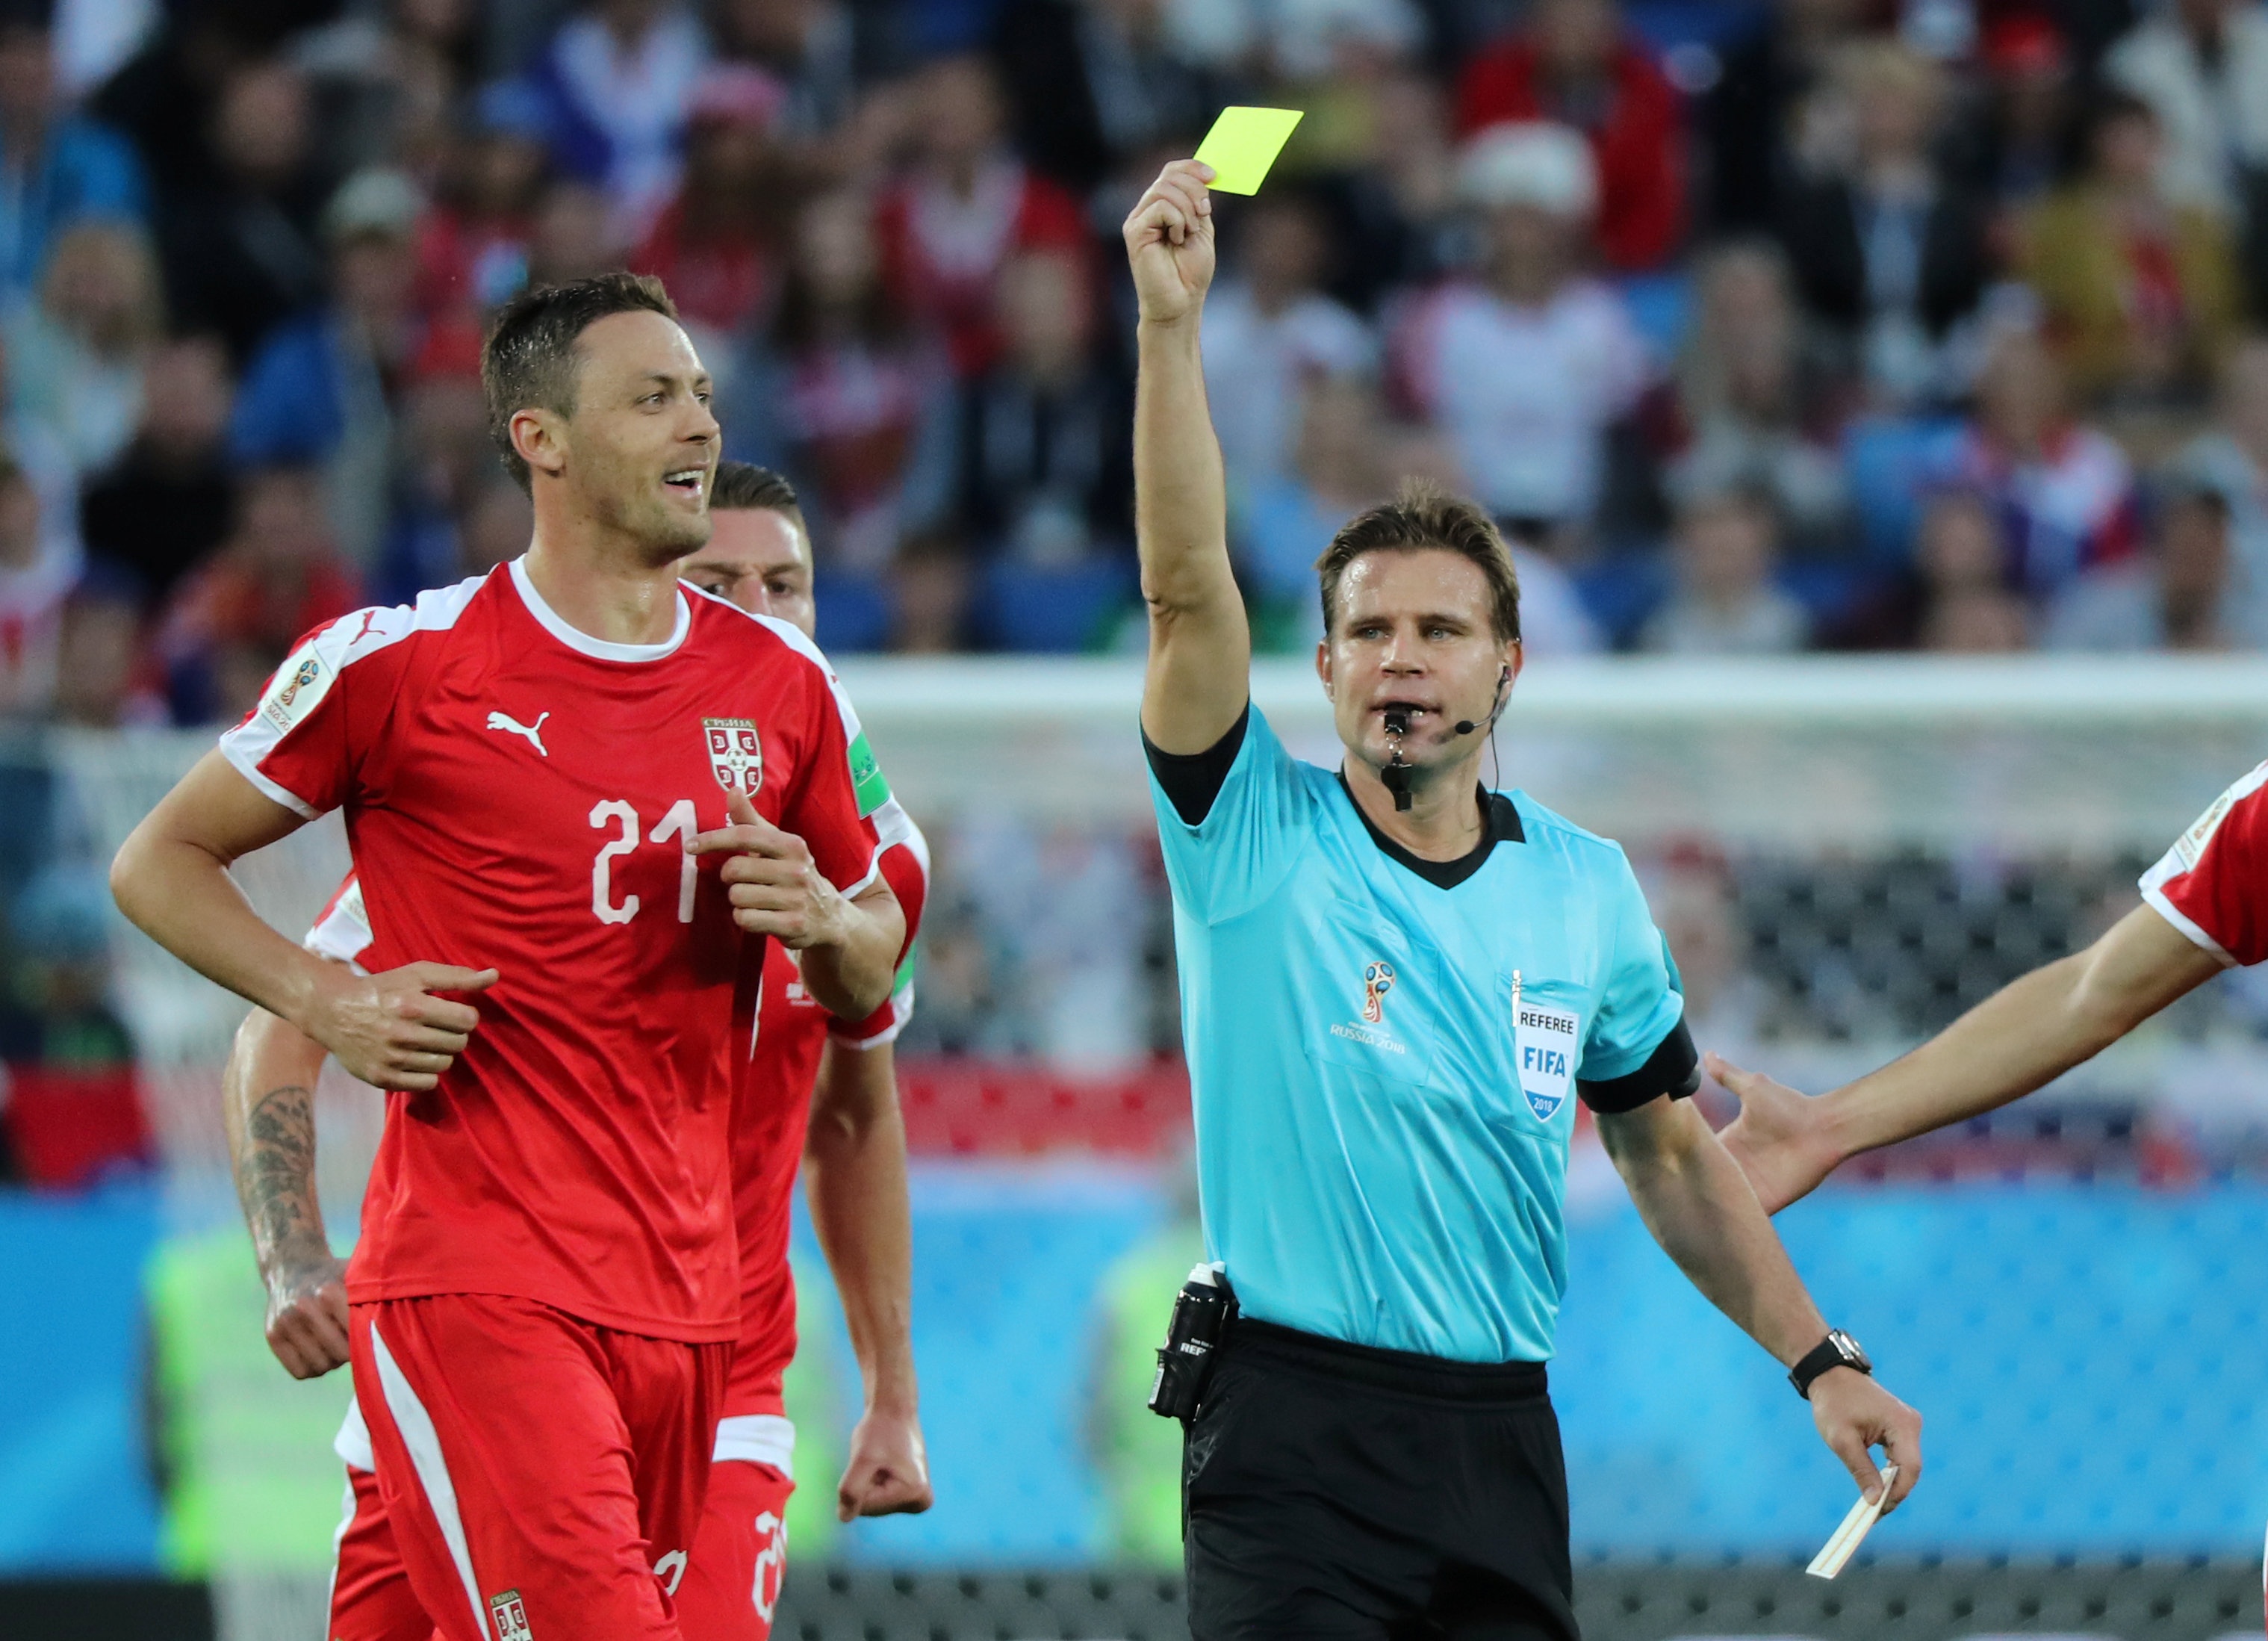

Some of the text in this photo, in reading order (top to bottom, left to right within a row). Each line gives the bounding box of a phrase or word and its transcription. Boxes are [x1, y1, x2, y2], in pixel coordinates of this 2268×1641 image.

[588, 799, 698, 925] 21
[1520, 1011, 1574, 1034] REFEREE
[1330, 1023, 1376, 1045] RUSSIA
[1376, 1036, 1405, 1055] 2018
[1523, 1046, 1566, 1078] FIFA
[1534, 1096, 1553, 1112] 2018
[1180, 1341, 1207, 1356] REF
